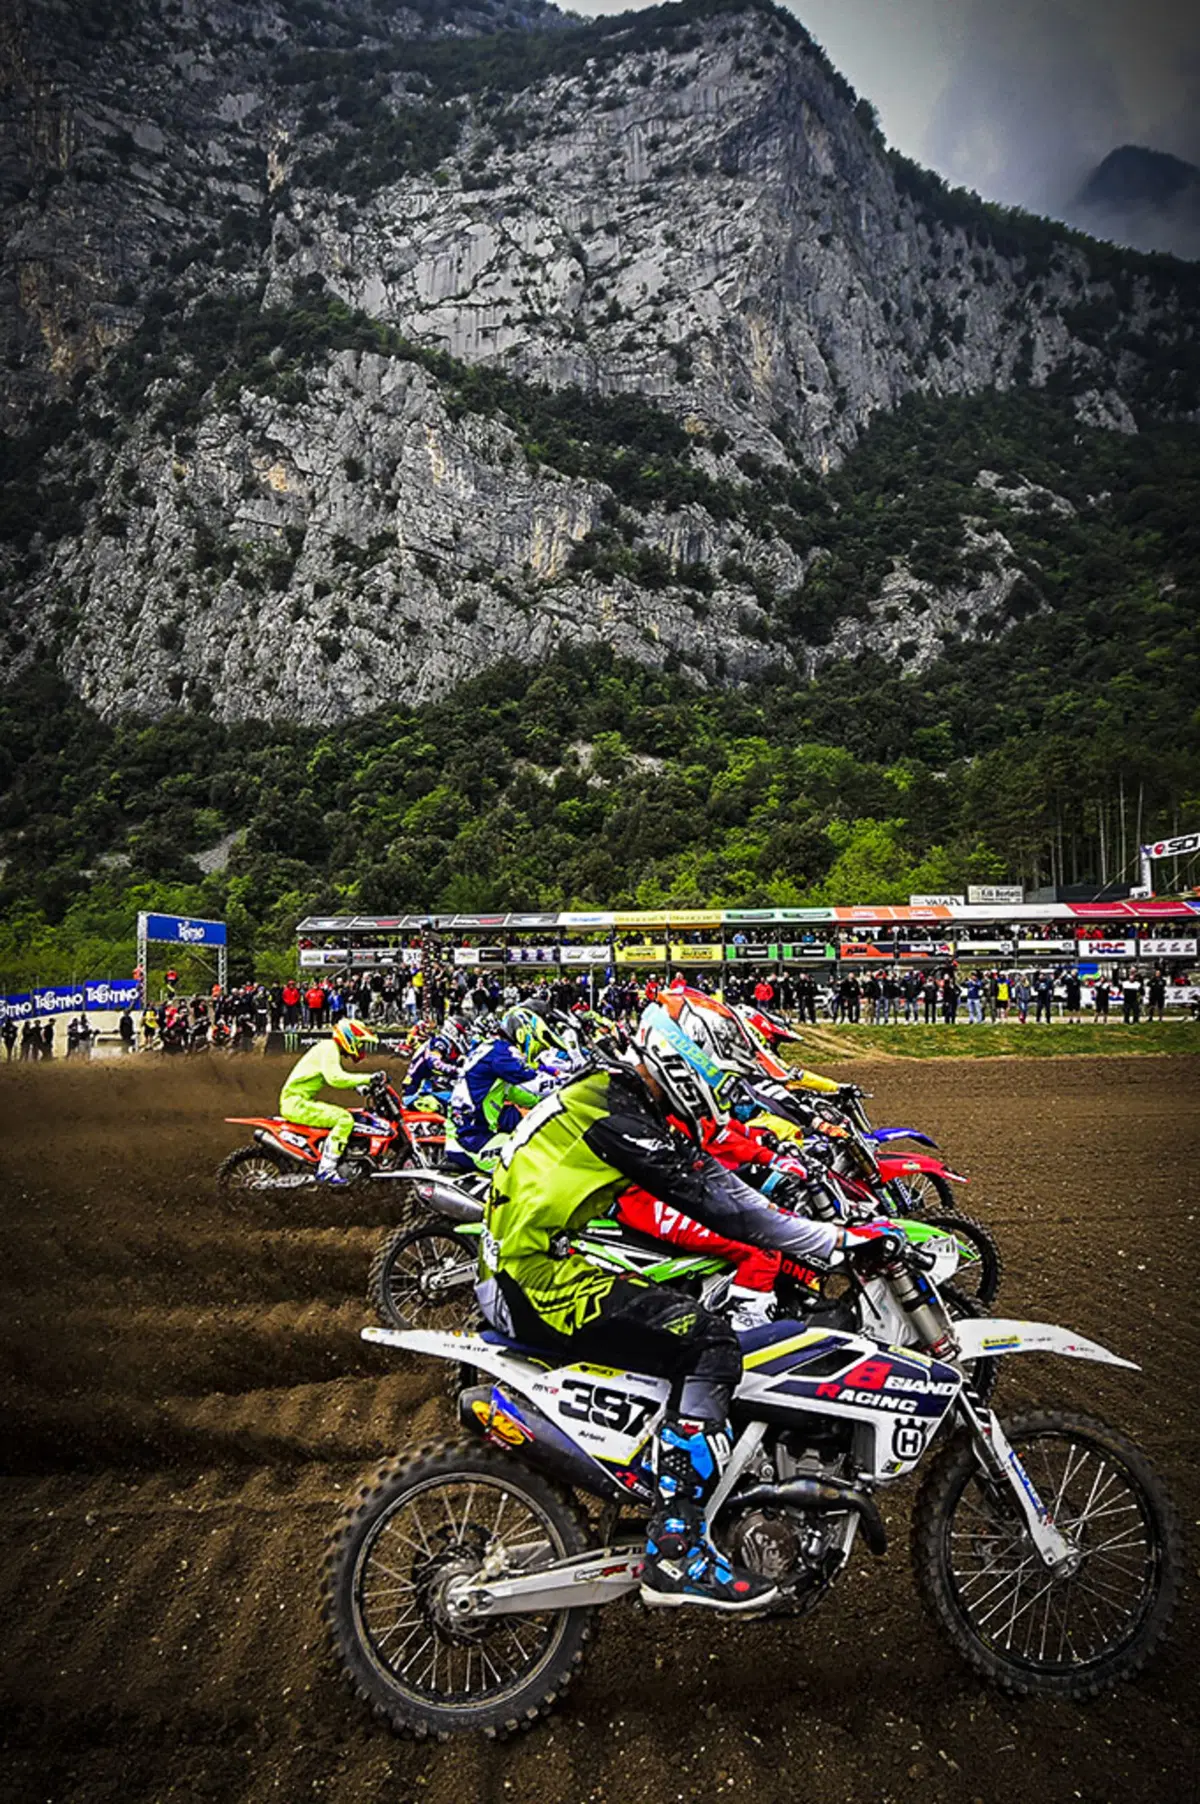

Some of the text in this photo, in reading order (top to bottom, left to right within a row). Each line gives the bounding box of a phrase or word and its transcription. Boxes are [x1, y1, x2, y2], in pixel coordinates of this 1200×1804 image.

[1088, 942, 1126, 954] HRC
[558, 1379, 661, 1438] 397
[815, 1383, 919, 1413] RACING
